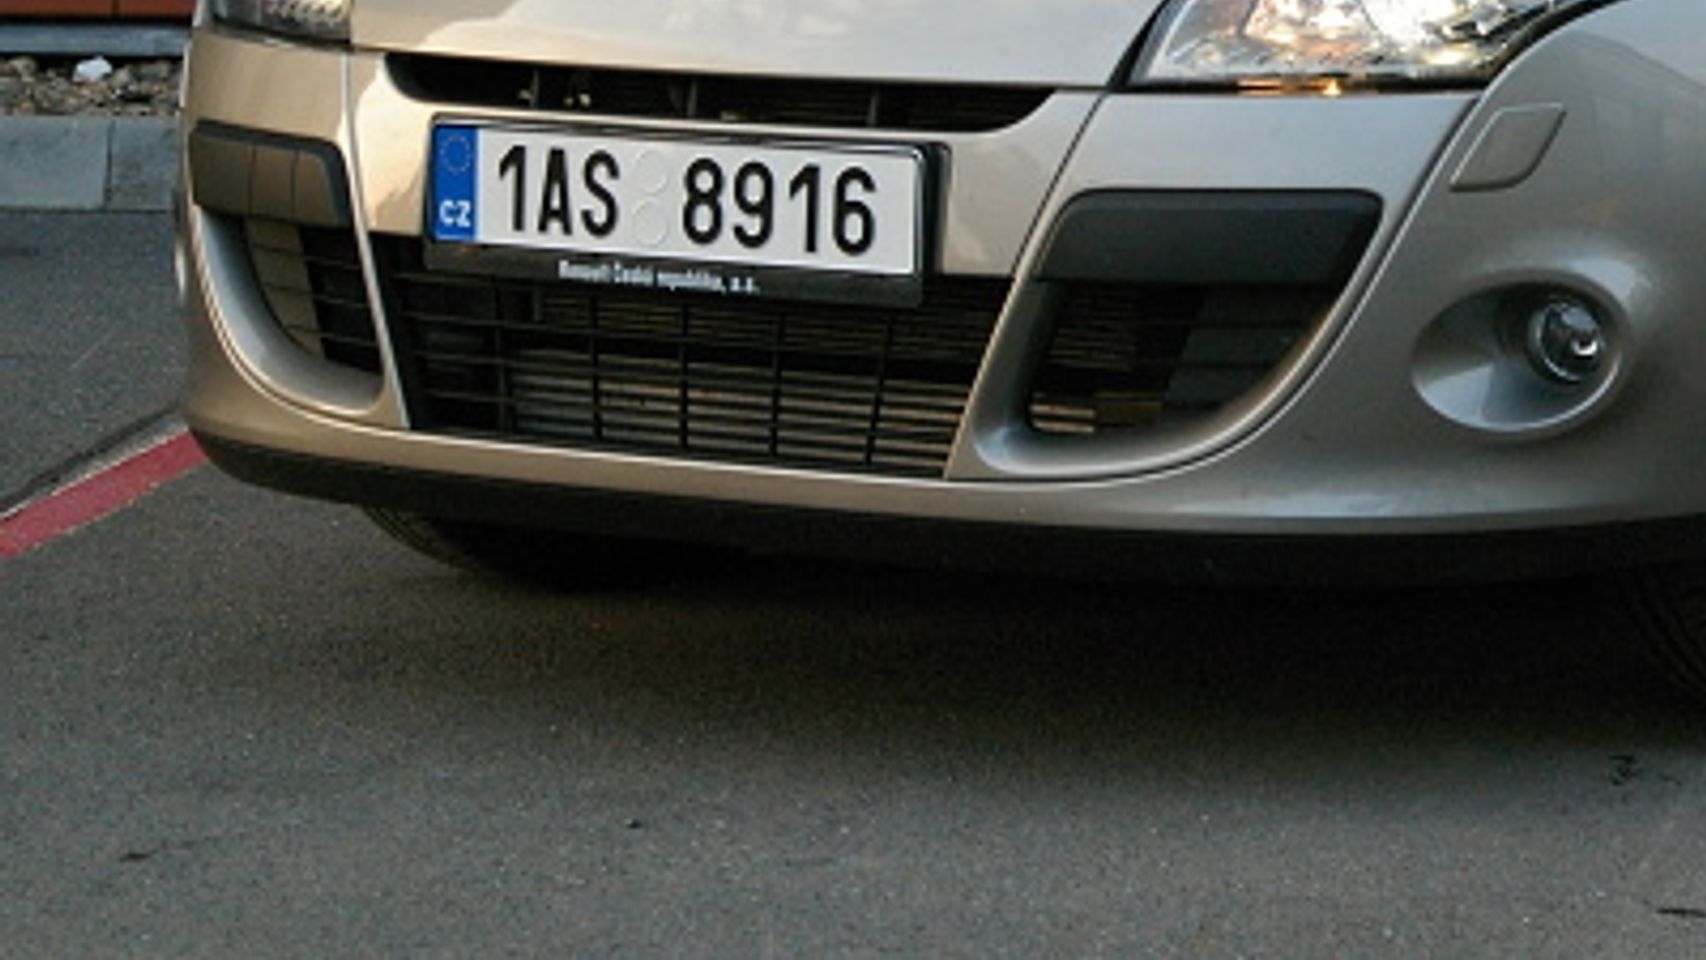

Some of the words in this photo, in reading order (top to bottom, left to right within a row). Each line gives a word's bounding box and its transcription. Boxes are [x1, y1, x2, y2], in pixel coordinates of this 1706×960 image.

[440, 199, 472, 227] CZ
[499, 145, 620, 238] 1AS
[682, 157, 877, 257] 8916
